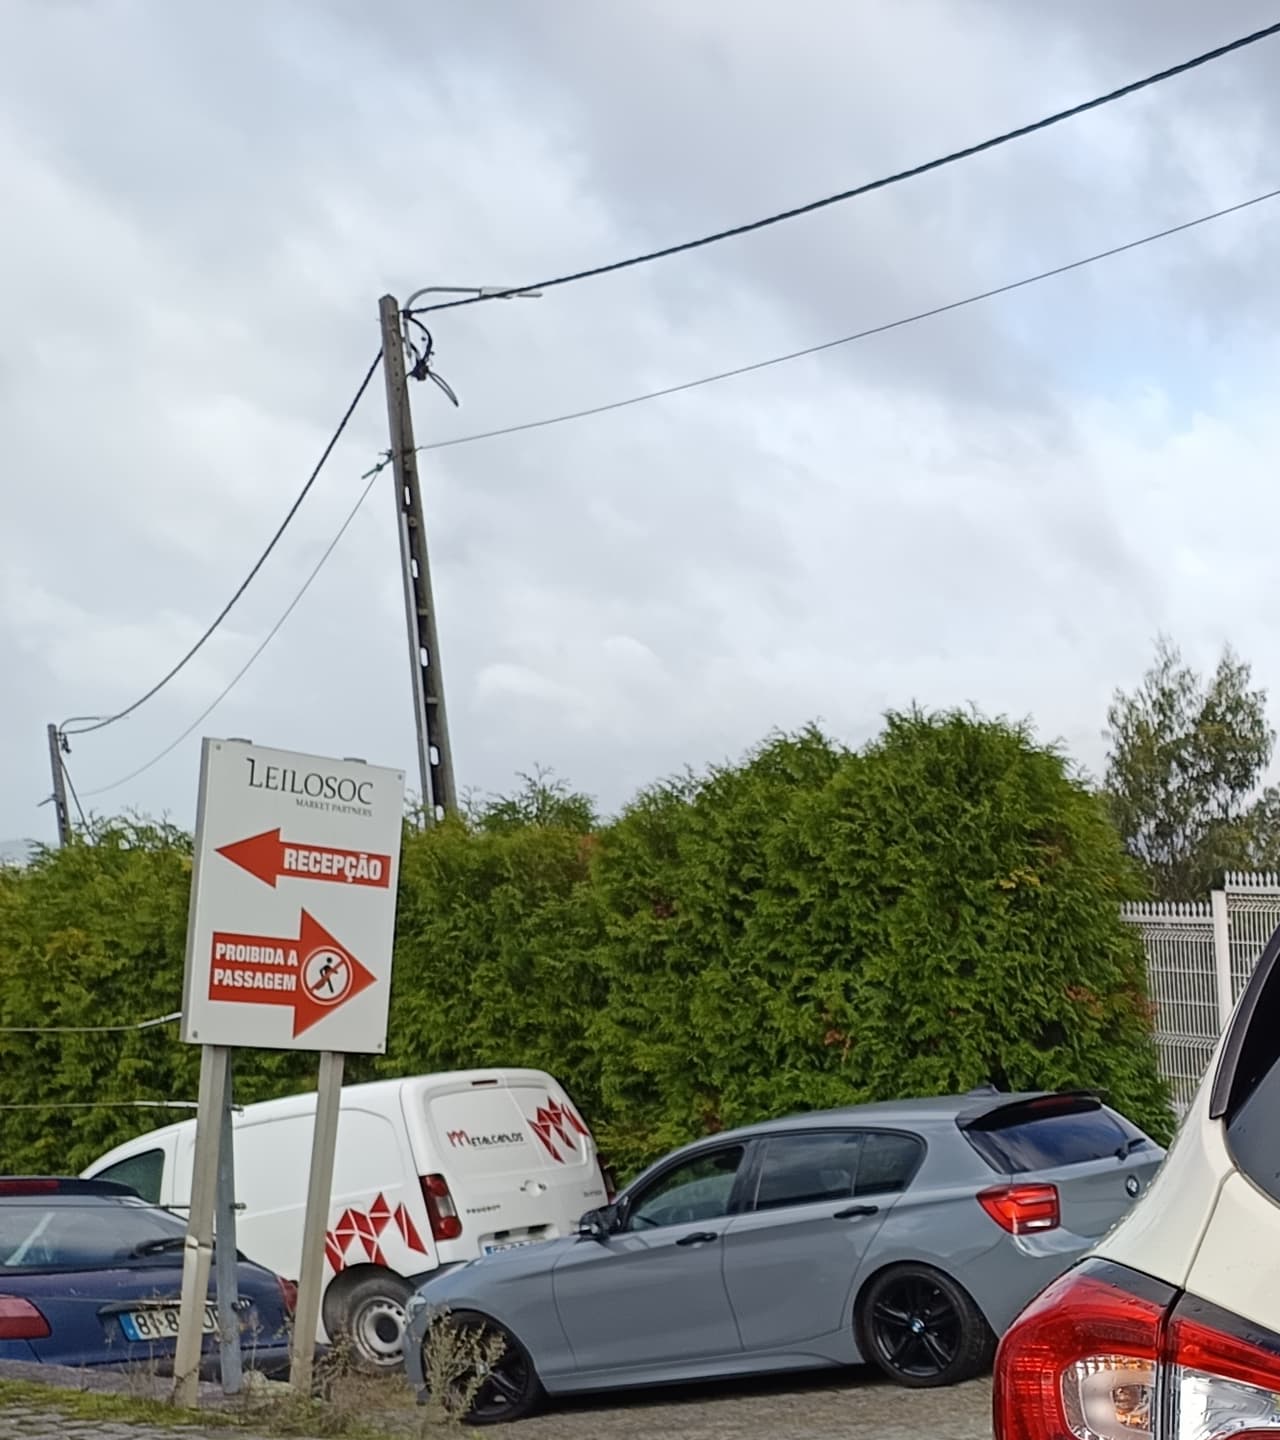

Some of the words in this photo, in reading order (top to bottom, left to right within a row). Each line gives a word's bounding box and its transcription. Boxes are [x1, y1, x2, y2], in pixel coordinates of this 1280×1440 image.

[246, 757, 374, 805] LEILOSOC
[296, 798, 330, 812] MARKET
[331, 803, 373, 817] PARTNERS
[283, 847, 382, 883] RECEPÇÃO
[215, 942, 285, 966] PROIBIDA
[287, 949, 298, 967] A
[213, 967, 297, 992] PASSAGEM
